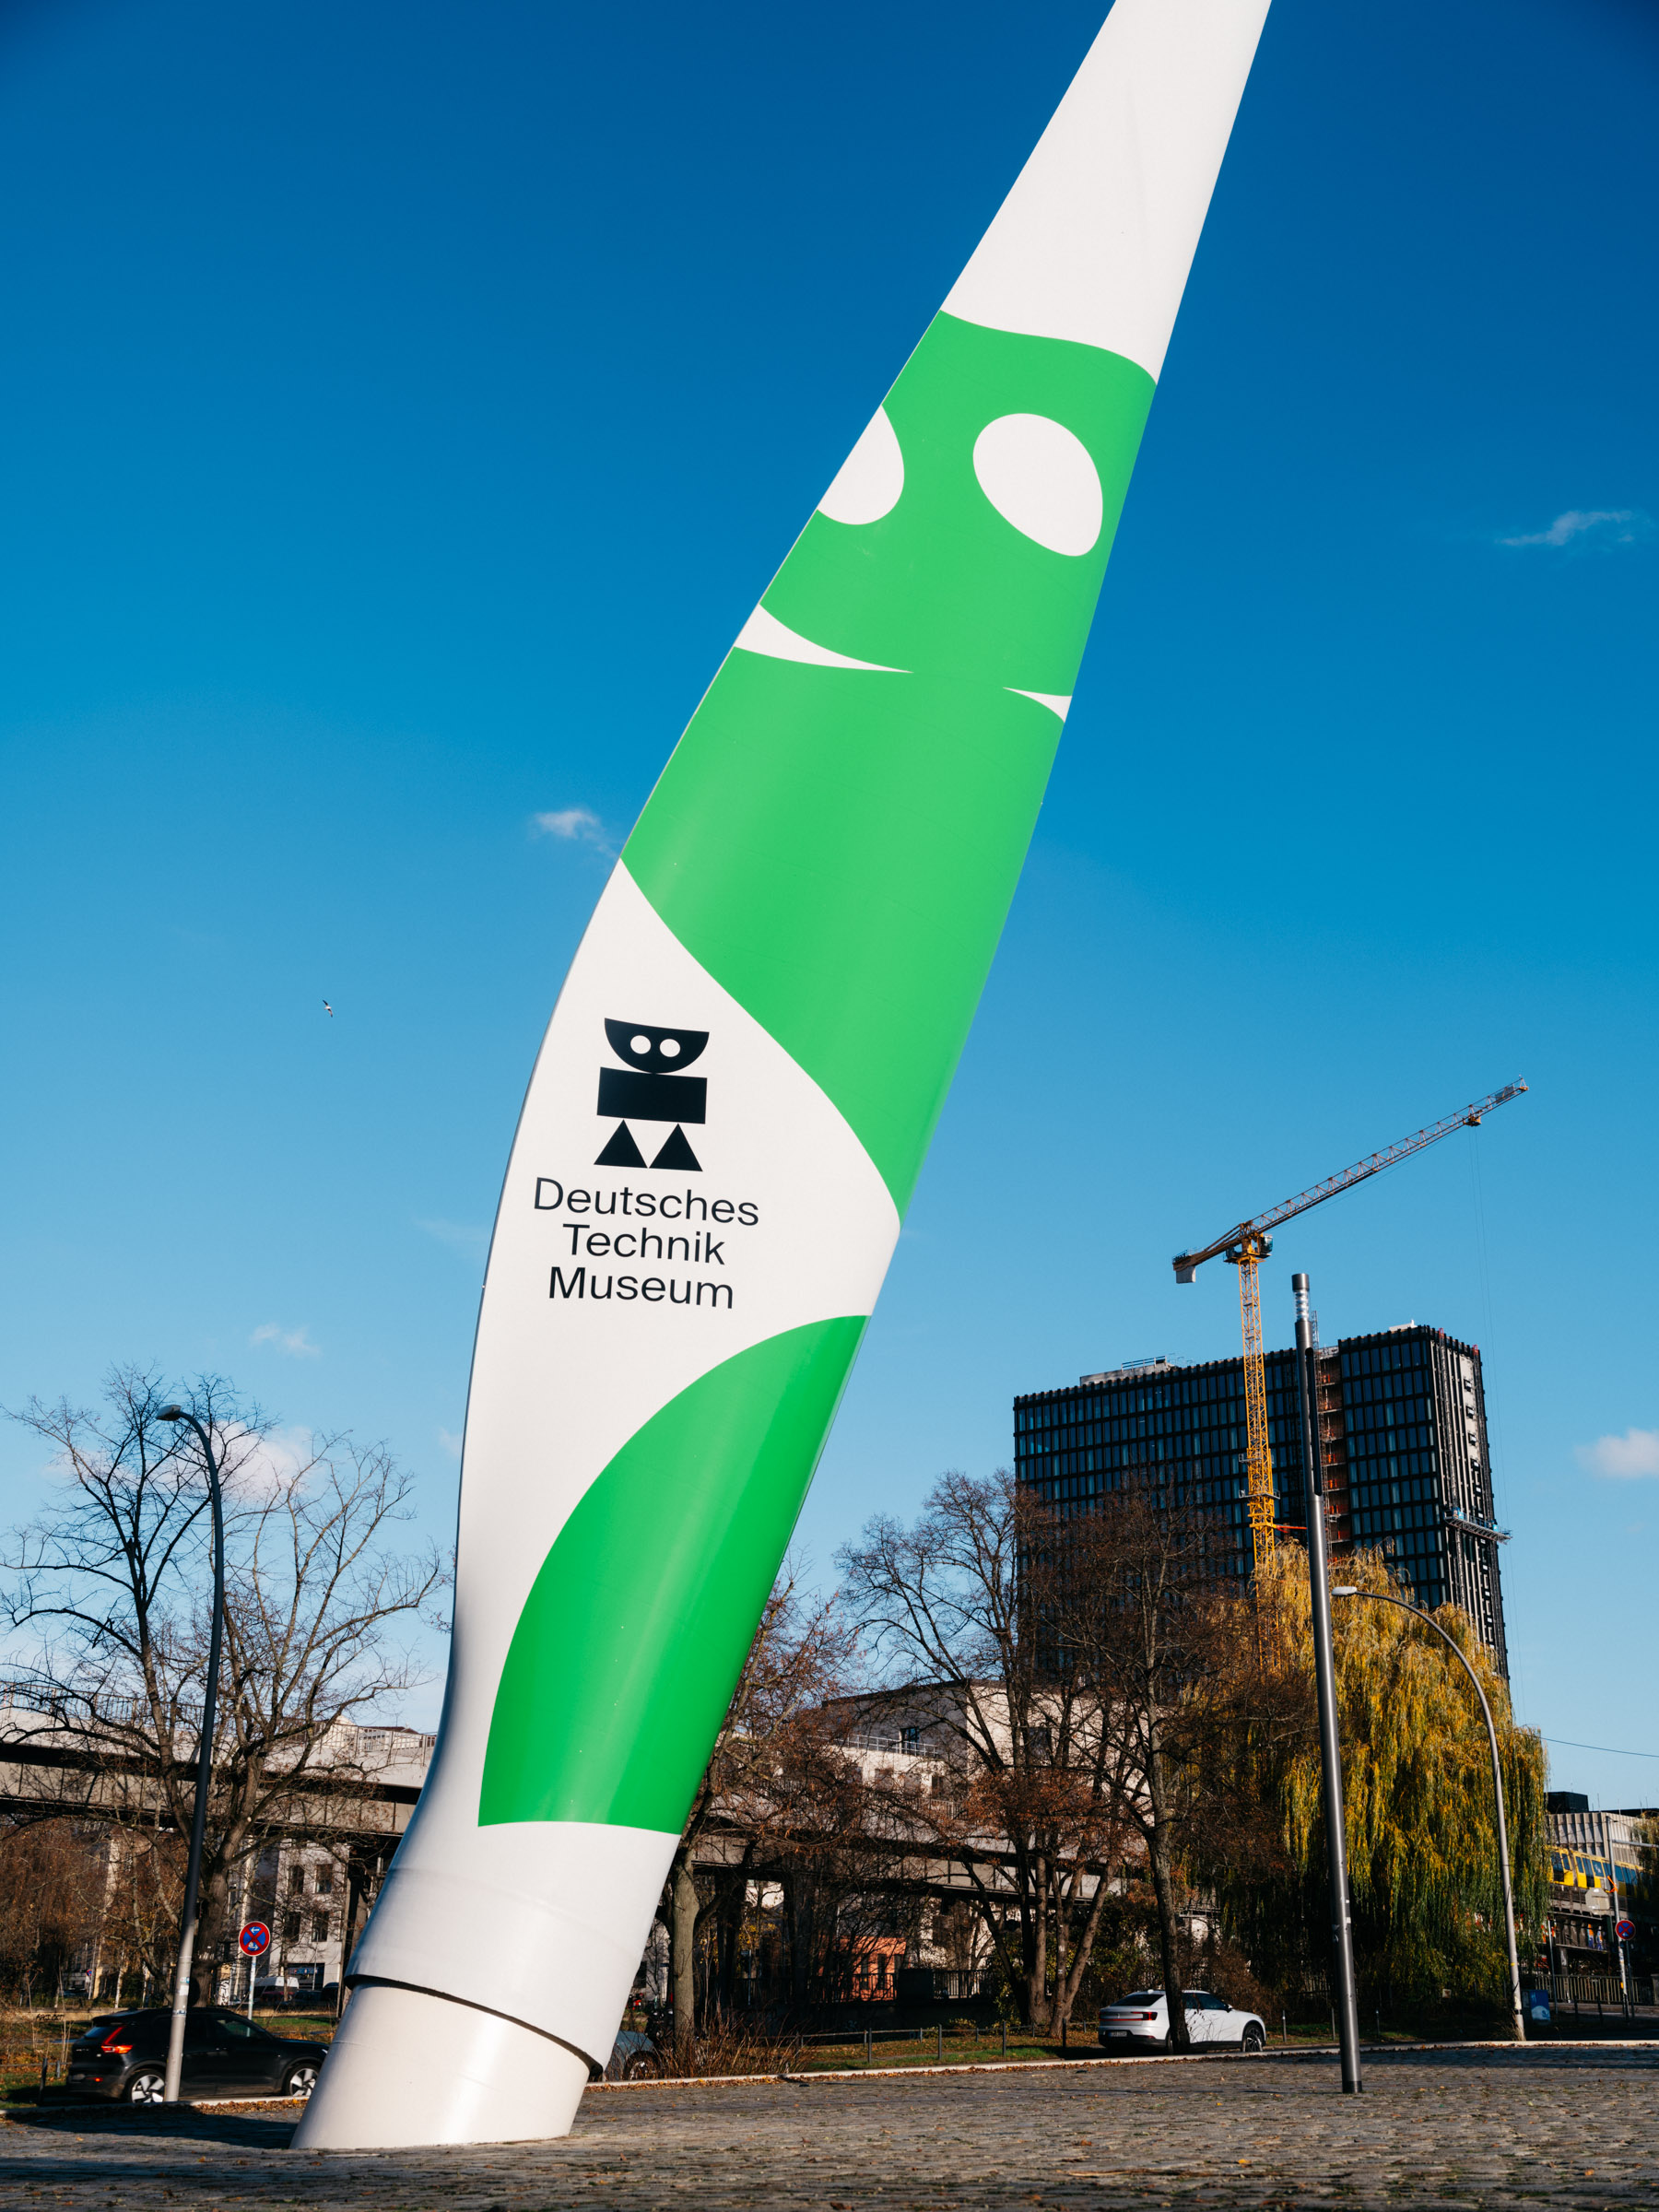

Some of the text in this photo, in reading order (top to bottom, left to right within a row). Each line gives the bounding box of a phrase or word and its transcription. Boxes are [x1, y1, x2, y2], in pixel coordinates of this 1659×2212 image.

[534, 1177, 759, 1227] Deutsches
[562, 1223, 725, 1265] Technik
[548, 1266, 734, 1310] Museum
